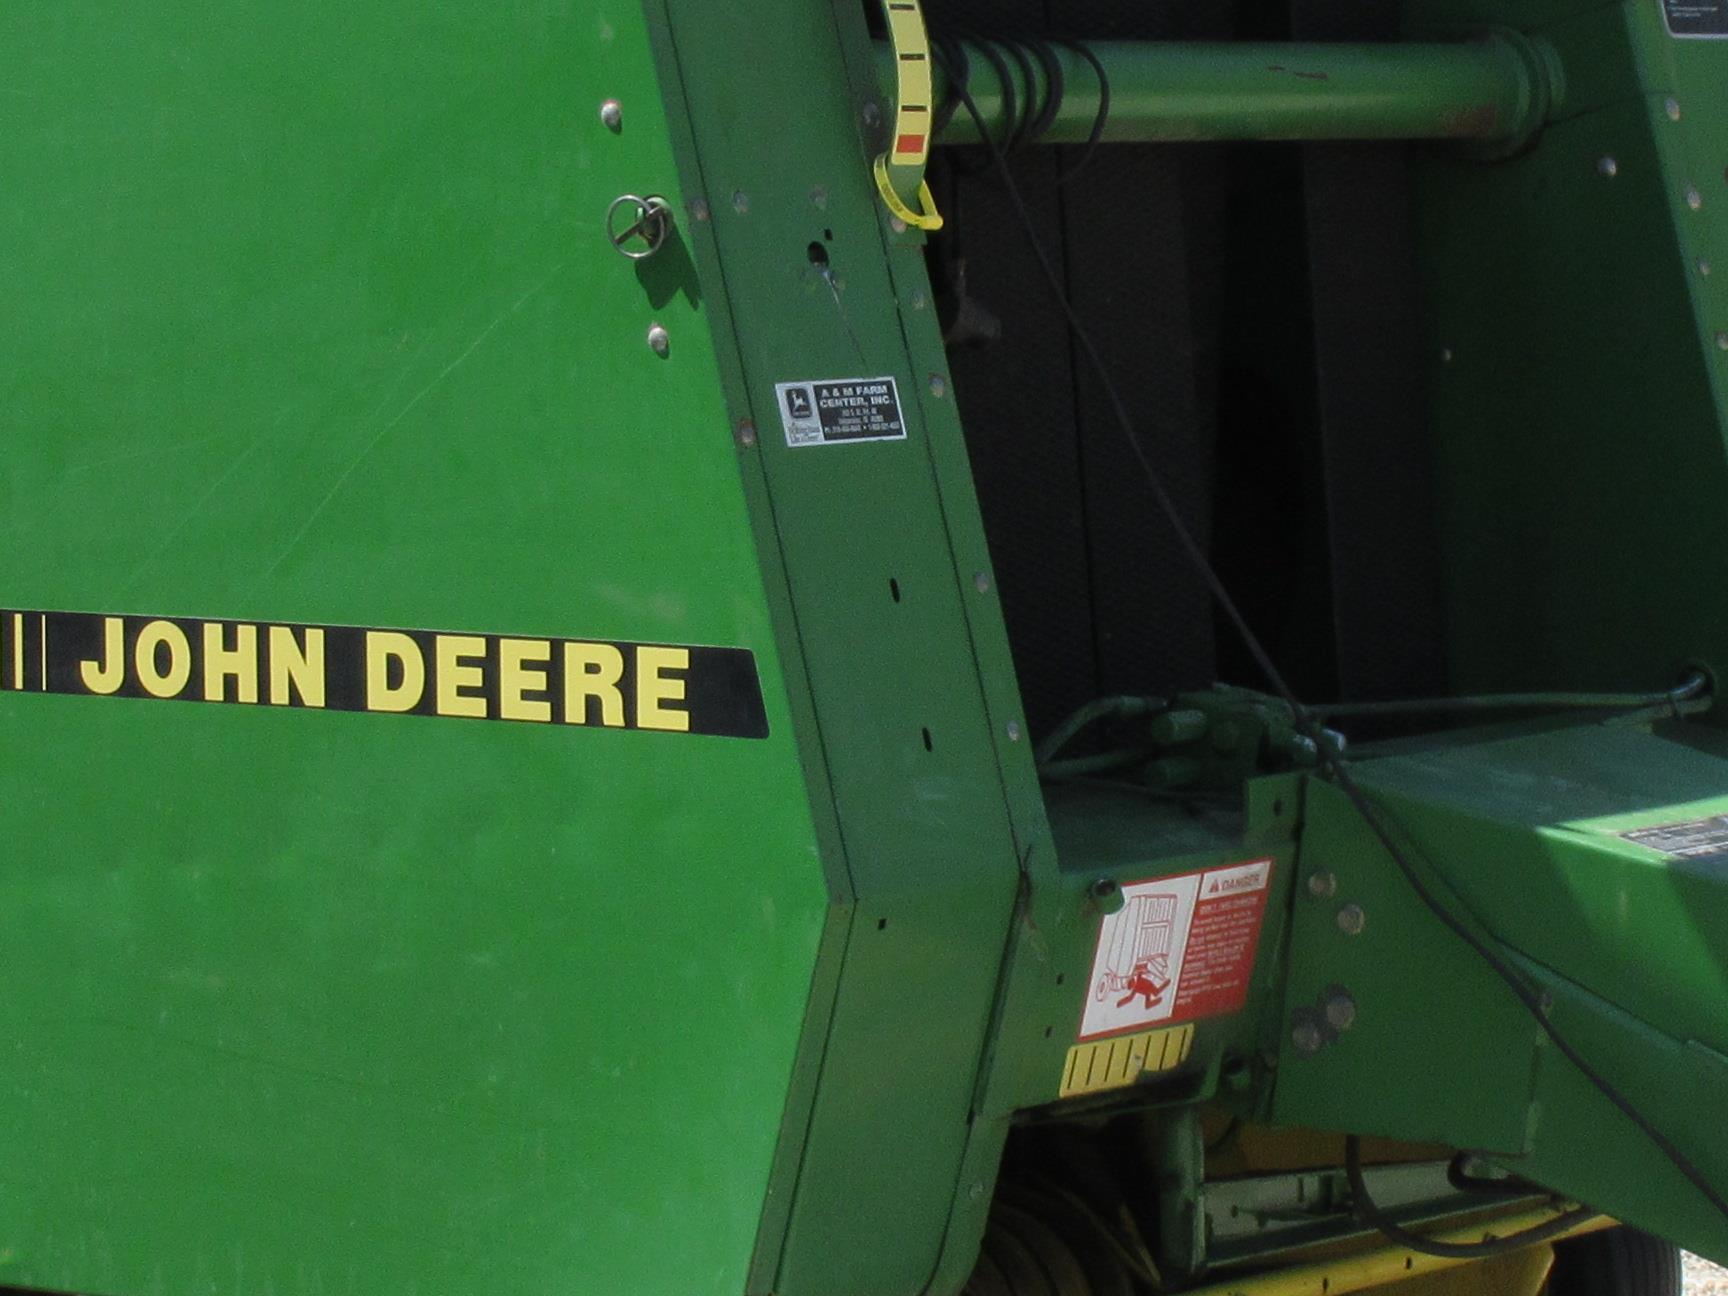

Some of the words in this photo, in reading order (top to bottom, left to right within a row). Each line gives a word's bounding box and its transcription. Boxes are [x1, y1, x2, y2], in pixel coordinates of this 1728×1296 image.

[821, 388, 830, 397] A
[832, 387, 840, 397] &
[842, 387, 855, 396] M
[856, 385, 888, 395] FARM
[820, 397, 868, 408] CENTER,
[870, 395, 894, 404] INC.
[79, 616, 326, 708] JOHN
[365, 630, 691, 732] DEERE
